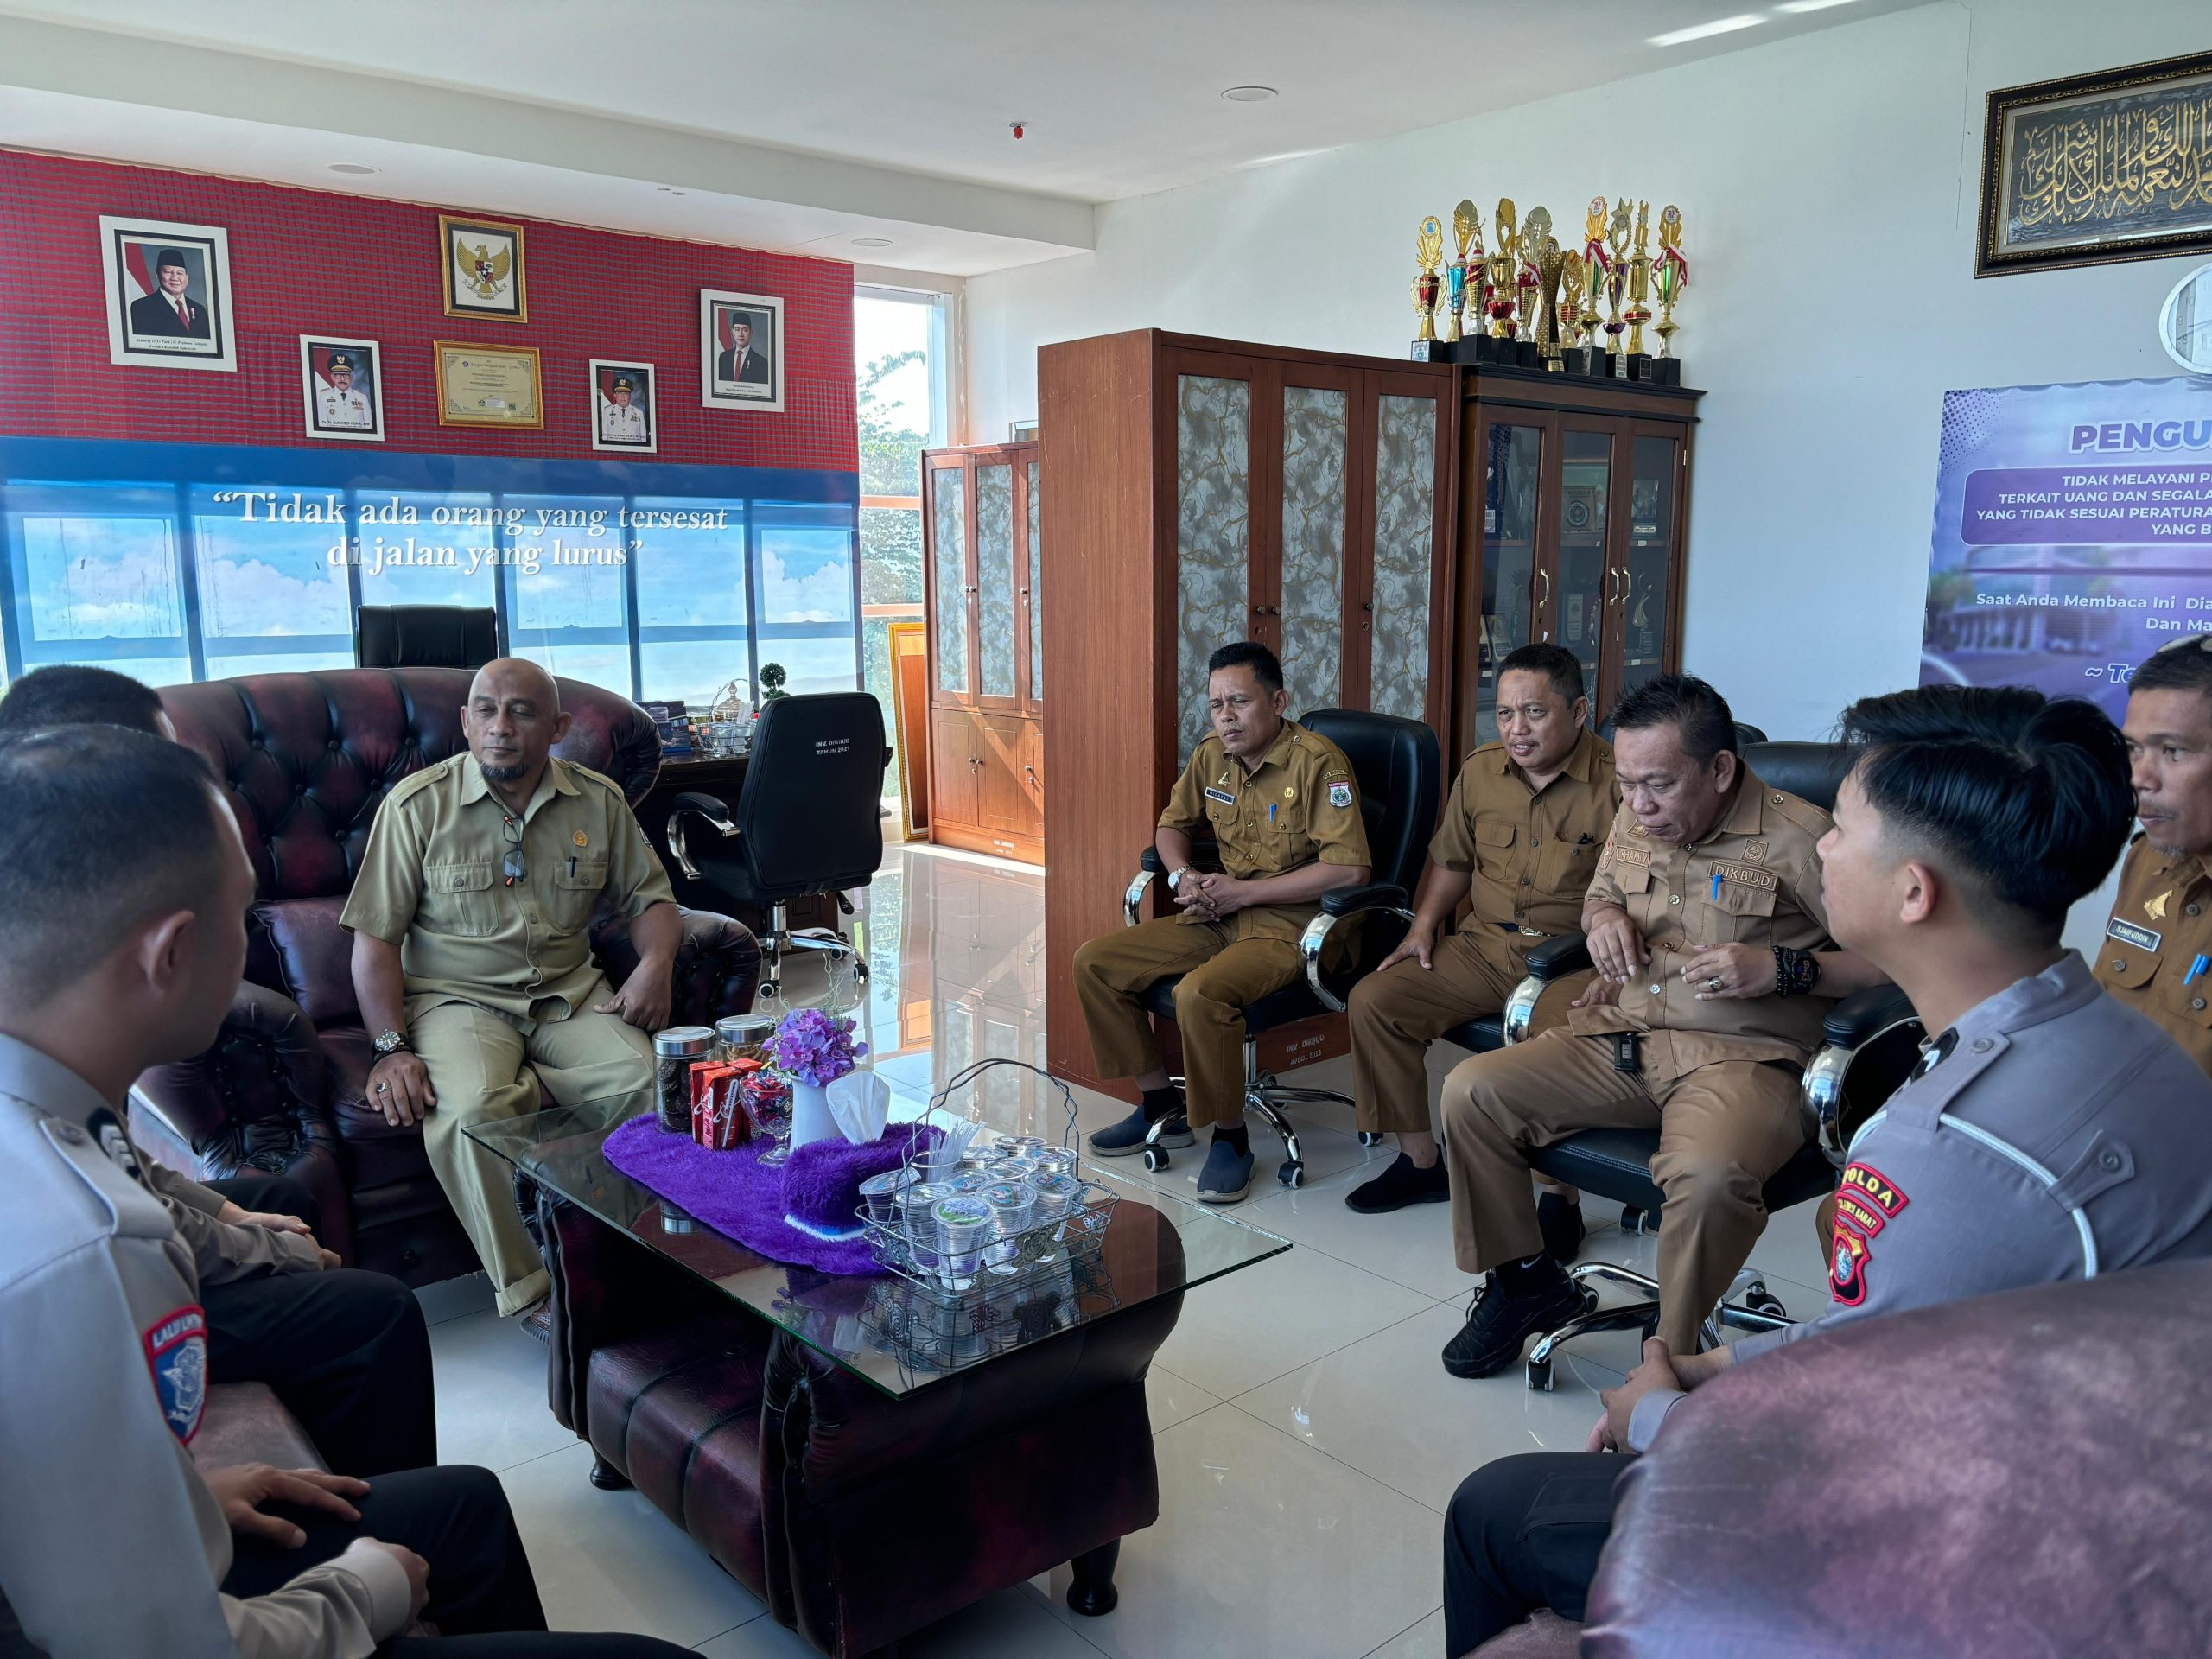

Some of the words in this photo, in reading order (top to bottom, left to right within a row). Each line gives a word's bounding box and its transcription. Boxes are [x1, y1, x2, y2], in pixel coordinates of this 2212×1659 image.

[2071, 418, 2212, 452] PENGU
[2061, 475, 2109, 487] TIDAK
[2113, 472, 2195, 486] MELAYANI
[1999, 492, 2062, 505] TERKAIT
[2064, 491, 2108, 503] UANG
[2112, 490, 2148, 502] DAN
[2151, 489, 2212, 501] SEGALA
[213, 491, 347, 524] “Tidak
[359, 496, 420, 526] ada
[431, 506, 526, 536] orang
[532, 508, 609, 537] yang
[617, 505, 728, 531] tersesat
[1976, 509, 2017, 520] YANG
[2020, 508, 2067, 520] TIDAK
[2069, 507, 2125, 519] SESUAI
[2128, 506, 2212, 518] PERATURA
[2151, 524, 2196, 536] YANG
[327, 537, 361, 566] di
[369, 537, 457, 576] jalan
[463, 546, 543, 575] yang
[551, 539, 644, 567] lurus”
[1976, 593, 2012, 606] Saat
[2015, 594, 2060, 607] Anda
[2063, 594, 2148, 608] Membaca
[2152, 595, 2176, 610] Ini
[2185, 596, 2212, 611] Dia
[2145, 617, 2182, 631] Dan
[2186, 619, 2212, 632] Ma
[1714, 865, 1770, 886] DIKBUD
[2116, 925, 2149, 942] SJAIFUDDIN
[1855, 1208, 1877, 1229] BARAT
